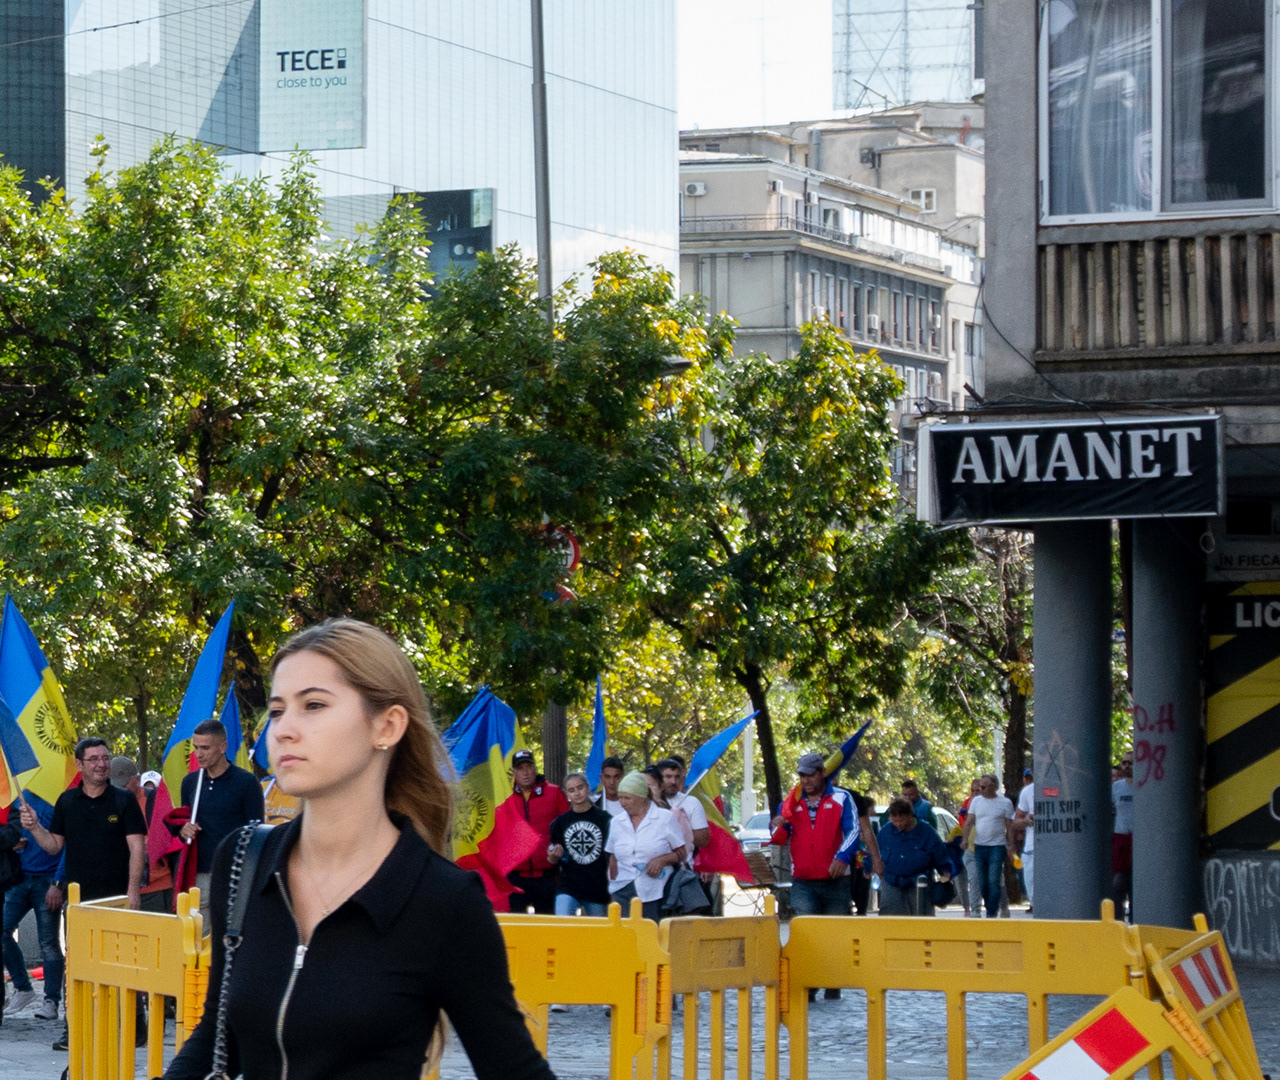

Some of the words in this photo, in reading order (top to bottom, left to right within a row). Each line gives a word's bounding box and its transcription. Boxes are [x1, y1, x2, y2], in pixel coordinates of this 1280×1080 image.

[276, 48, 336, 73] TECE
[276, 76, 308, 89] close
[310, 76, 321, 88] to
[324, 75, 347, 90] you
[951, 427, 1202, 485] AMANET
[1135, 739, 1167, 787] 98
